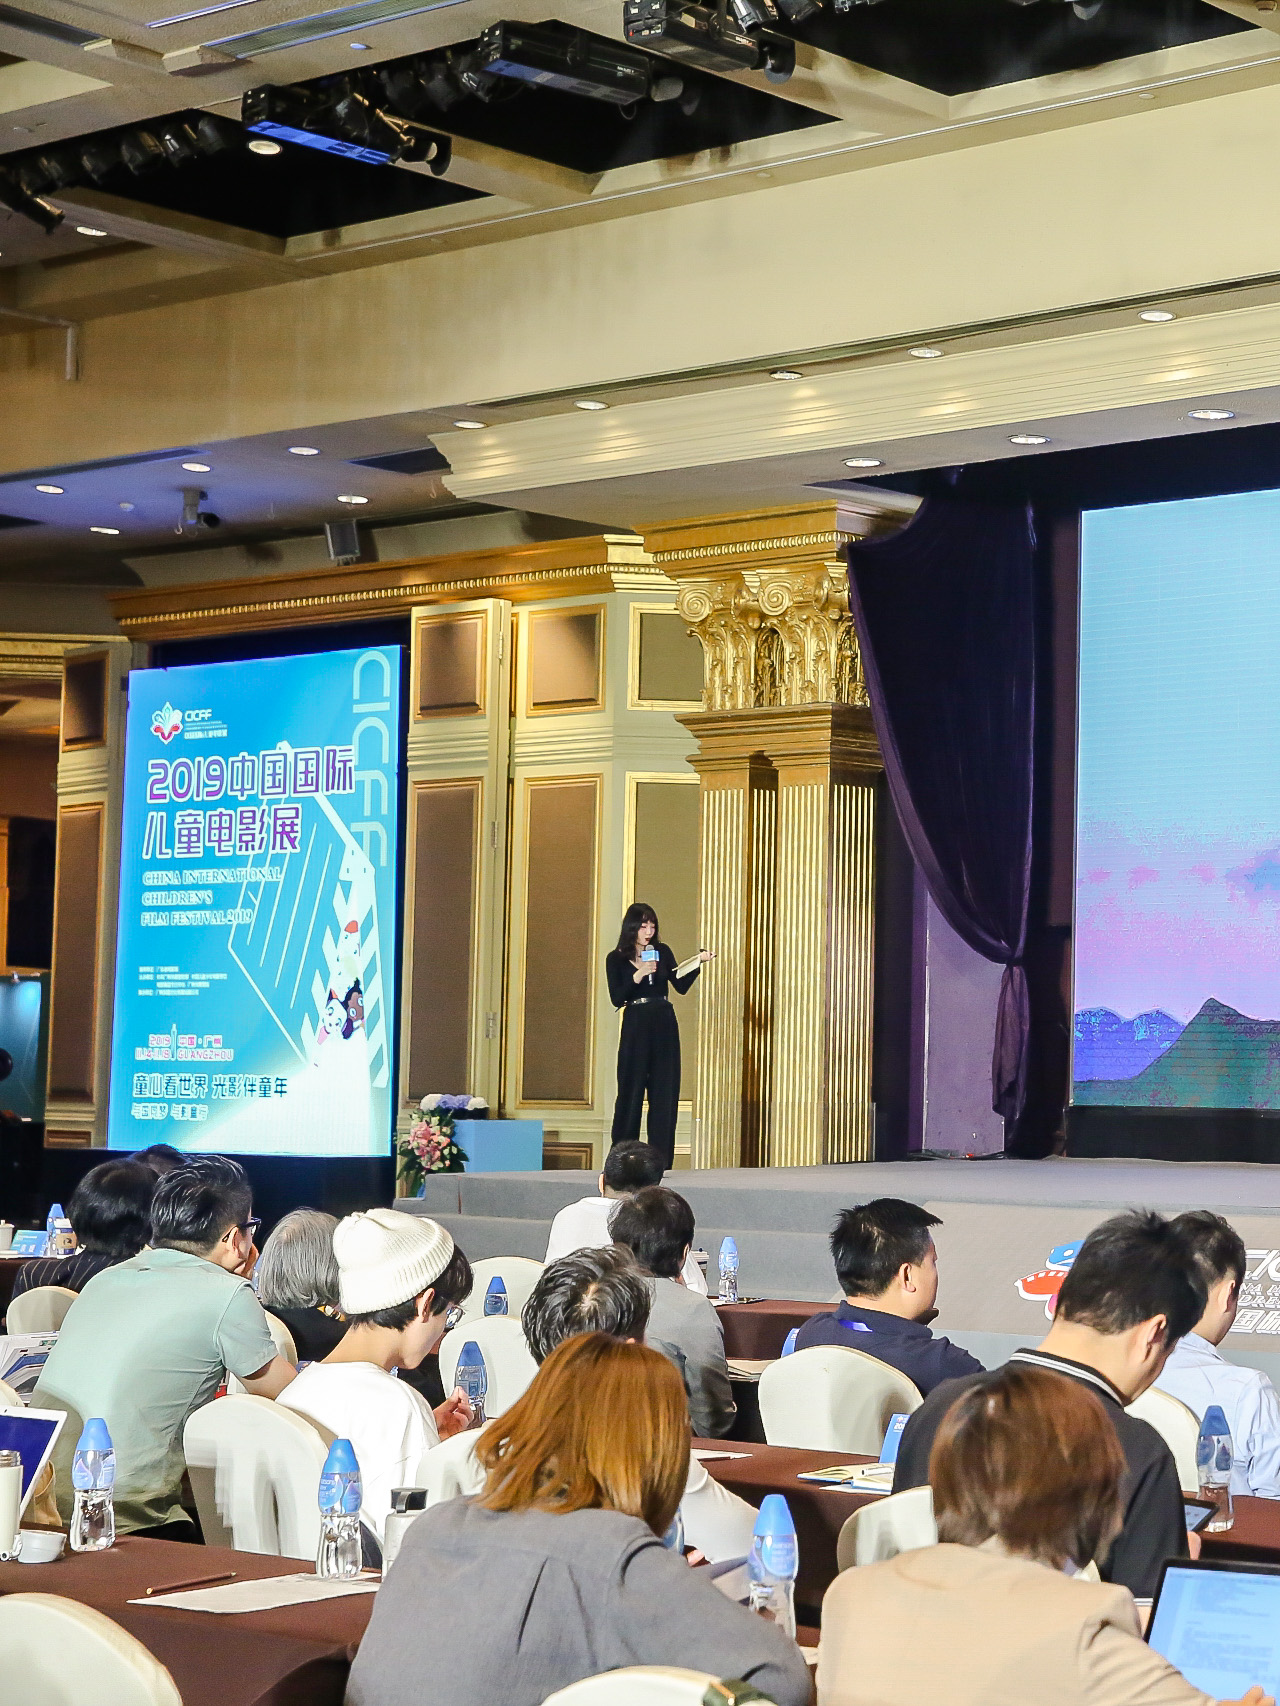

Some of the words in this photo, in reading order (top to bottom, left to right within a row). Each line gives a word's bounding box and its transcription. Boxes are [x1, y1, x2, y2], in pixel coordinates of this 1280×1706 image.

[147, 745, 355, 803] 2019中国国际
[142, 804, 301, 859] 儿童电影展
[142, 871, 181, 886] CHINA
[183, 867, 282, 885] INTERNATIONAL
[141, 890, 213, 906] CHILDREN'S
[140, 912, 169, 926] FILM
[171, 911, 226, 925] FESTIVAL
[226, 908, 253, 925] 2019
[133, 1073, 208, 1098] 童心看世界
[211, 1074, 287, 1099] 光影伴童年
